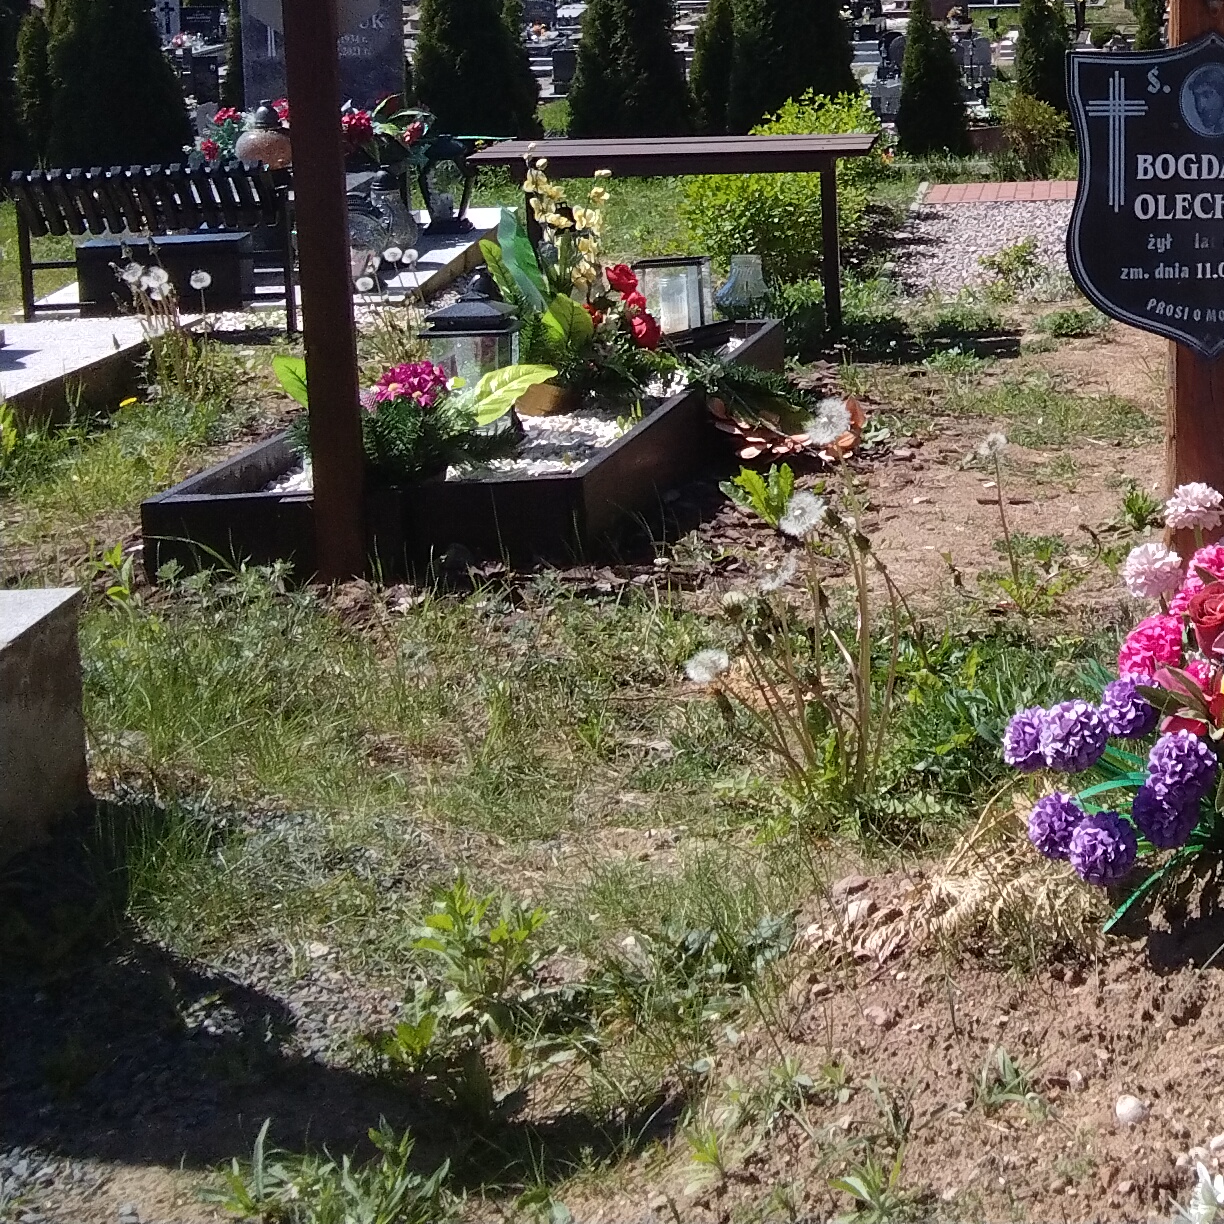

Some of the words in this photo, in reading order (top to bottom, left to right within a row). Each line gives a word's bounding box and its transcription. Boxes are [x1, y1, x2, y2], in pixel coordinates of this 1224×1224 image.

[1147, 233, 1173, 253] żył
[1120, 267, 1150, 280] zm.
[1154, 262, 1190, 279] dnia
[1146, 297, 1188, 321] PROSI
[1193, 308, 1201, 322] O
